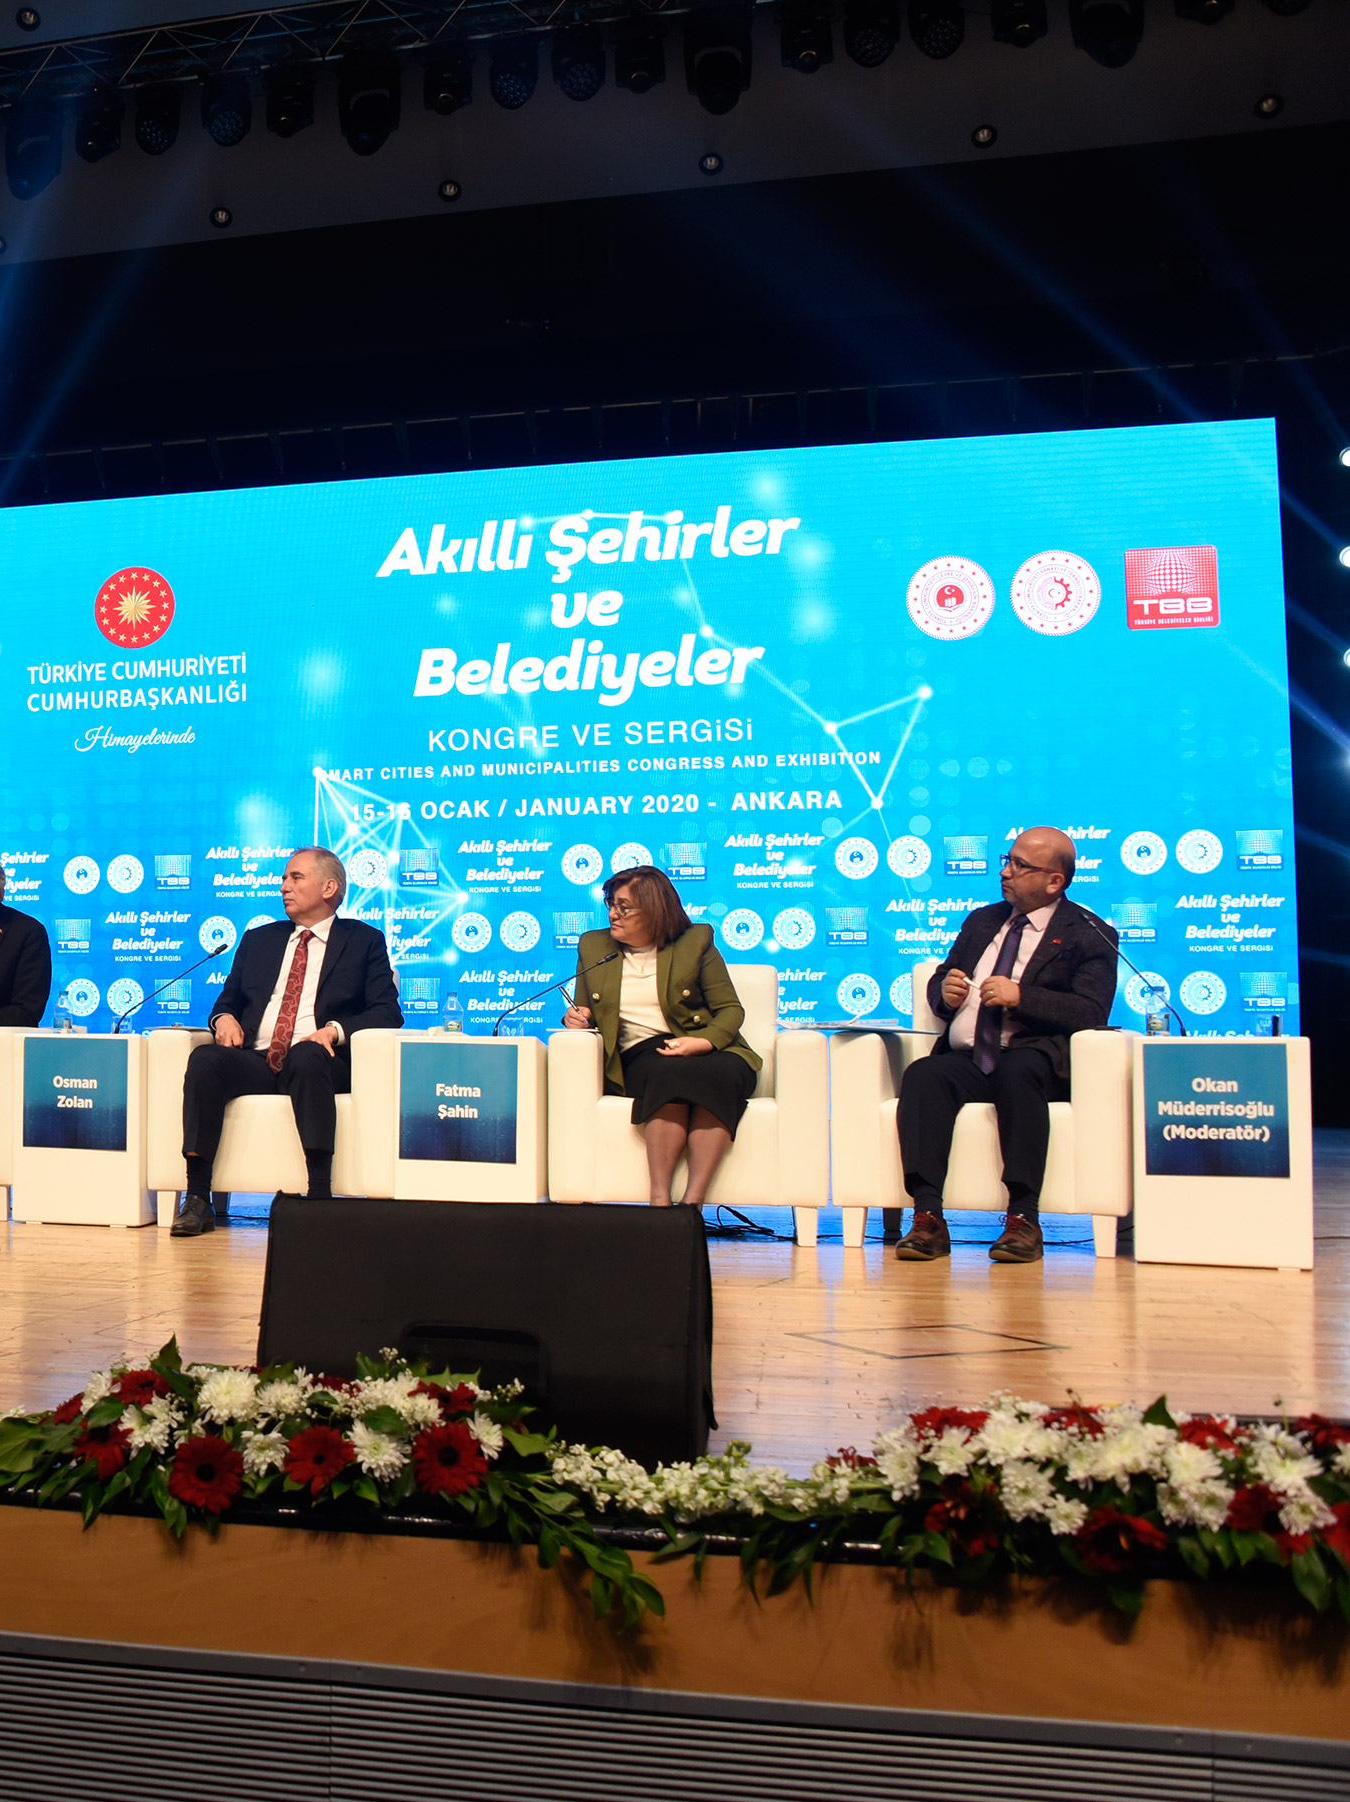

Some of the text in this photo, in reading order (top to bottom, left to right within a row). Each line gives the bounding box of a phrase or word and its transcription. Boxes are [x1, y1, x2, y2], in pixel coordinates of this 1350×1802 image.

[375, 505, 801, 583] Akıllı Şehirler
[550, 590, 624, 628] ve
[1133, 597, 1213, 615] TBB
[27, 652, 247, 684] TÜRKİYE CUMHURİYETİ
[413, 633, 766, 707] Belediyeler
[27, 680, 247, 712] CUMHURBAŞKANLIĞI
[74, 725, 196, 753] Himayelerinde
[429, 725, 559, 752] KONGRE
[572, 723, 611, 746] VE
[319, 751, 881, 781] MART CITIES AND MUNICIPALITIES CONGRESS AND EXHIBITION
[351, 803, 412, 821] 15-16
[420, 800, 490, 820] OCAK
[498, 799, 508, 817] /
[515, 796, 634, 817] JANUARY
[641, 794, 700, 813] 2020
[731, 790, 843, 811] ANKARA
[457, 839, 552, 856] Akıllı Şehirler
[723, 833, 825, 850] Akıllı Şehirler
[0, 851, 50, 867] Şehirler
[241, 845, 295, 862] Şehirler
[497, 855, 514, 867] ve
[766, 850, 784, 862] ve
[1239, 855, 1282, 864] TBB
[242, 862, 258, 872] ve
[668, 867, 705, 875] TBB
[733, 862, 817, 879] Belediyeler
[947, 861, 987, 869] TBB
[157, 877, 190, 885] TBB
[401, 872, 438, 881] TBB
[466, 867, 545, 884] Belediyeler
[885, 898, 925, 912] Akıllı
[1175, 894, 1285, 912] Akıllı Şehirler
[139, 911, 191, 927] Şehirler
[384, 906, 440, 923] Şehirler
[928, 916, 947, 926] ve
[1221, 911, 1241, 923] ve
[140, 926, 156, 937] ve
[555, 935, 580, 944] TB
[828, 931, 867, 940] TBB
[895, 928, 961, 945] Belediye
[1185, 924, 1276, 942] Belediyeler
[57, 941, 90, 949] TBB
[112, 937, 184, 953] Belediyeler
[458, 970, 554, 986] Akıllı Şehirler
[777, 968, 827, 981] ehirler
[498, 987, 515, 997] ve
[157, 1001, 190, 1010] TBB
[403, 1001, 439, 1009] TBB
[1244, 998, 1286, 1007] TBB
[53, 1075, 98, 1090] Osman
[436, 1083, 481, 1098] Fatma
[1191, 1077, 1239, 1093] Okan
[57, 1094, 93, 1109] Zolan
[437, 1104, 479, 1120] Şahin
[1158, 1101, 1275, 1119] Müderrisoğlu
[1162, 1124, 1271, 1143] (Moderatör)
